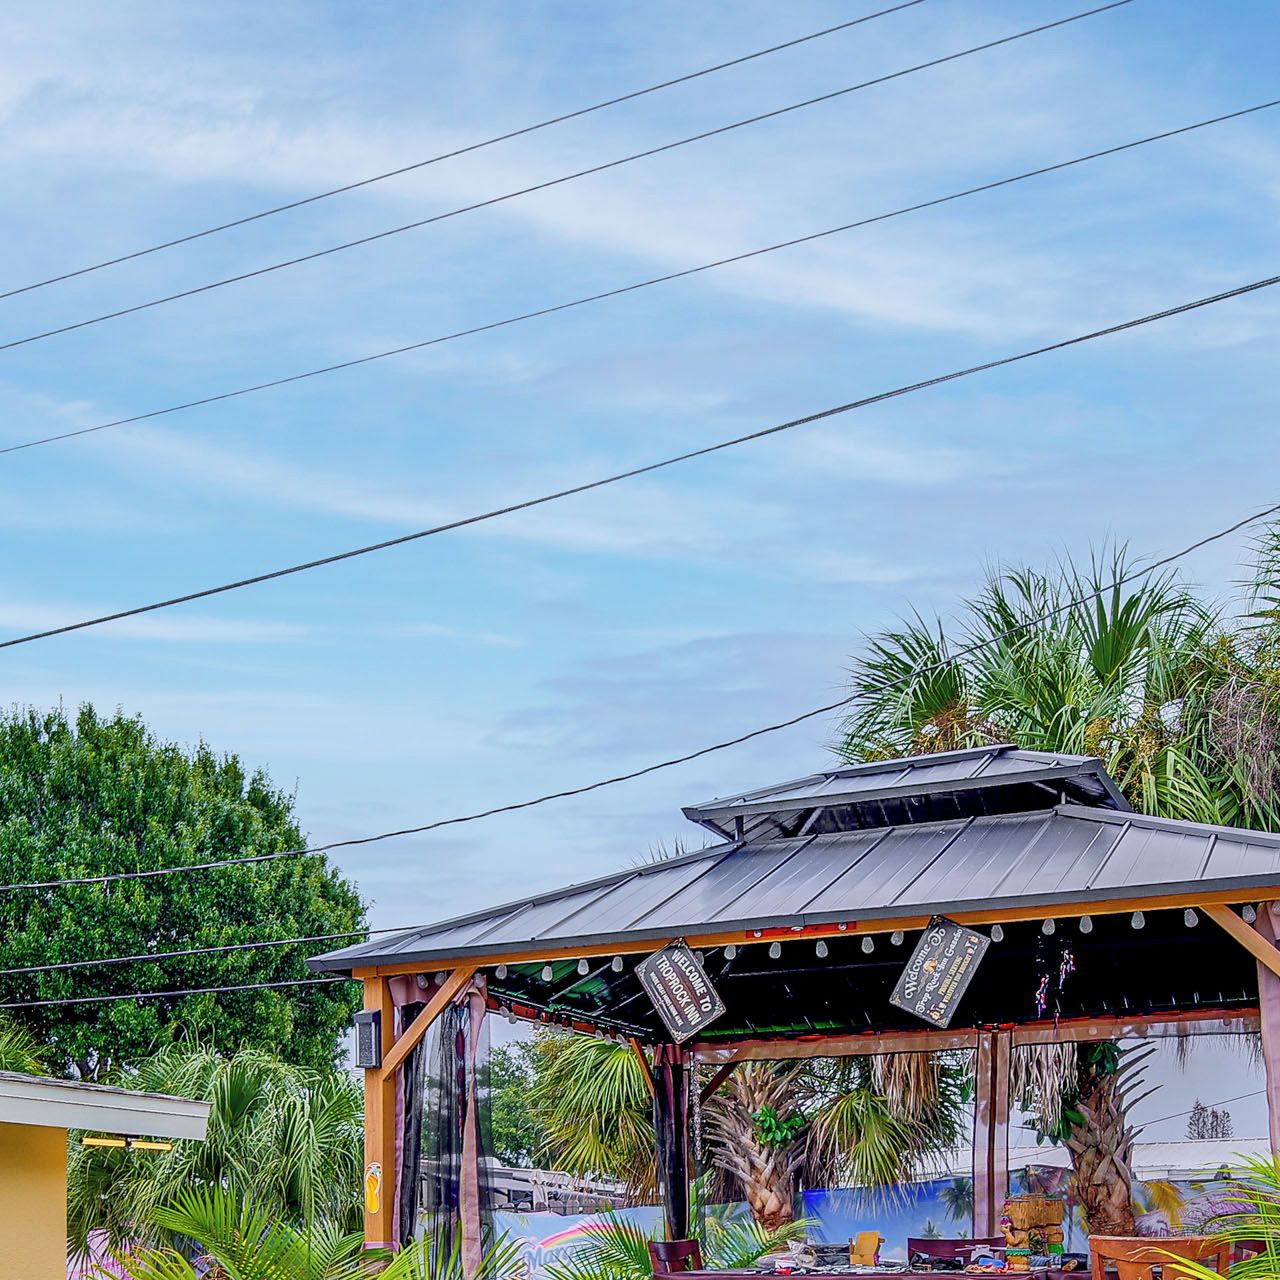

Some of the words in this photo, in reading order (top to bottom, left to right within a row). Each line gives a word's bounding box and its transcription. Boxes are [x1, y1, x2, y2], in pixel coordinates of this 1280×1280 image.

[655, 955, 691, 1007] TROPROCK
[684, 1003, 702, 1025] INN
[671, 950, 707, 996] WELCOME
[700, 995, 712, 1012] TO
[905, 944, 931, 998] Welcome
[928, 927, 946, 946] To
[915, 993, 931, 1013] Trop
[925, 970, 941, 993] Rock
[945, 928, 962, 956] Gazebo
